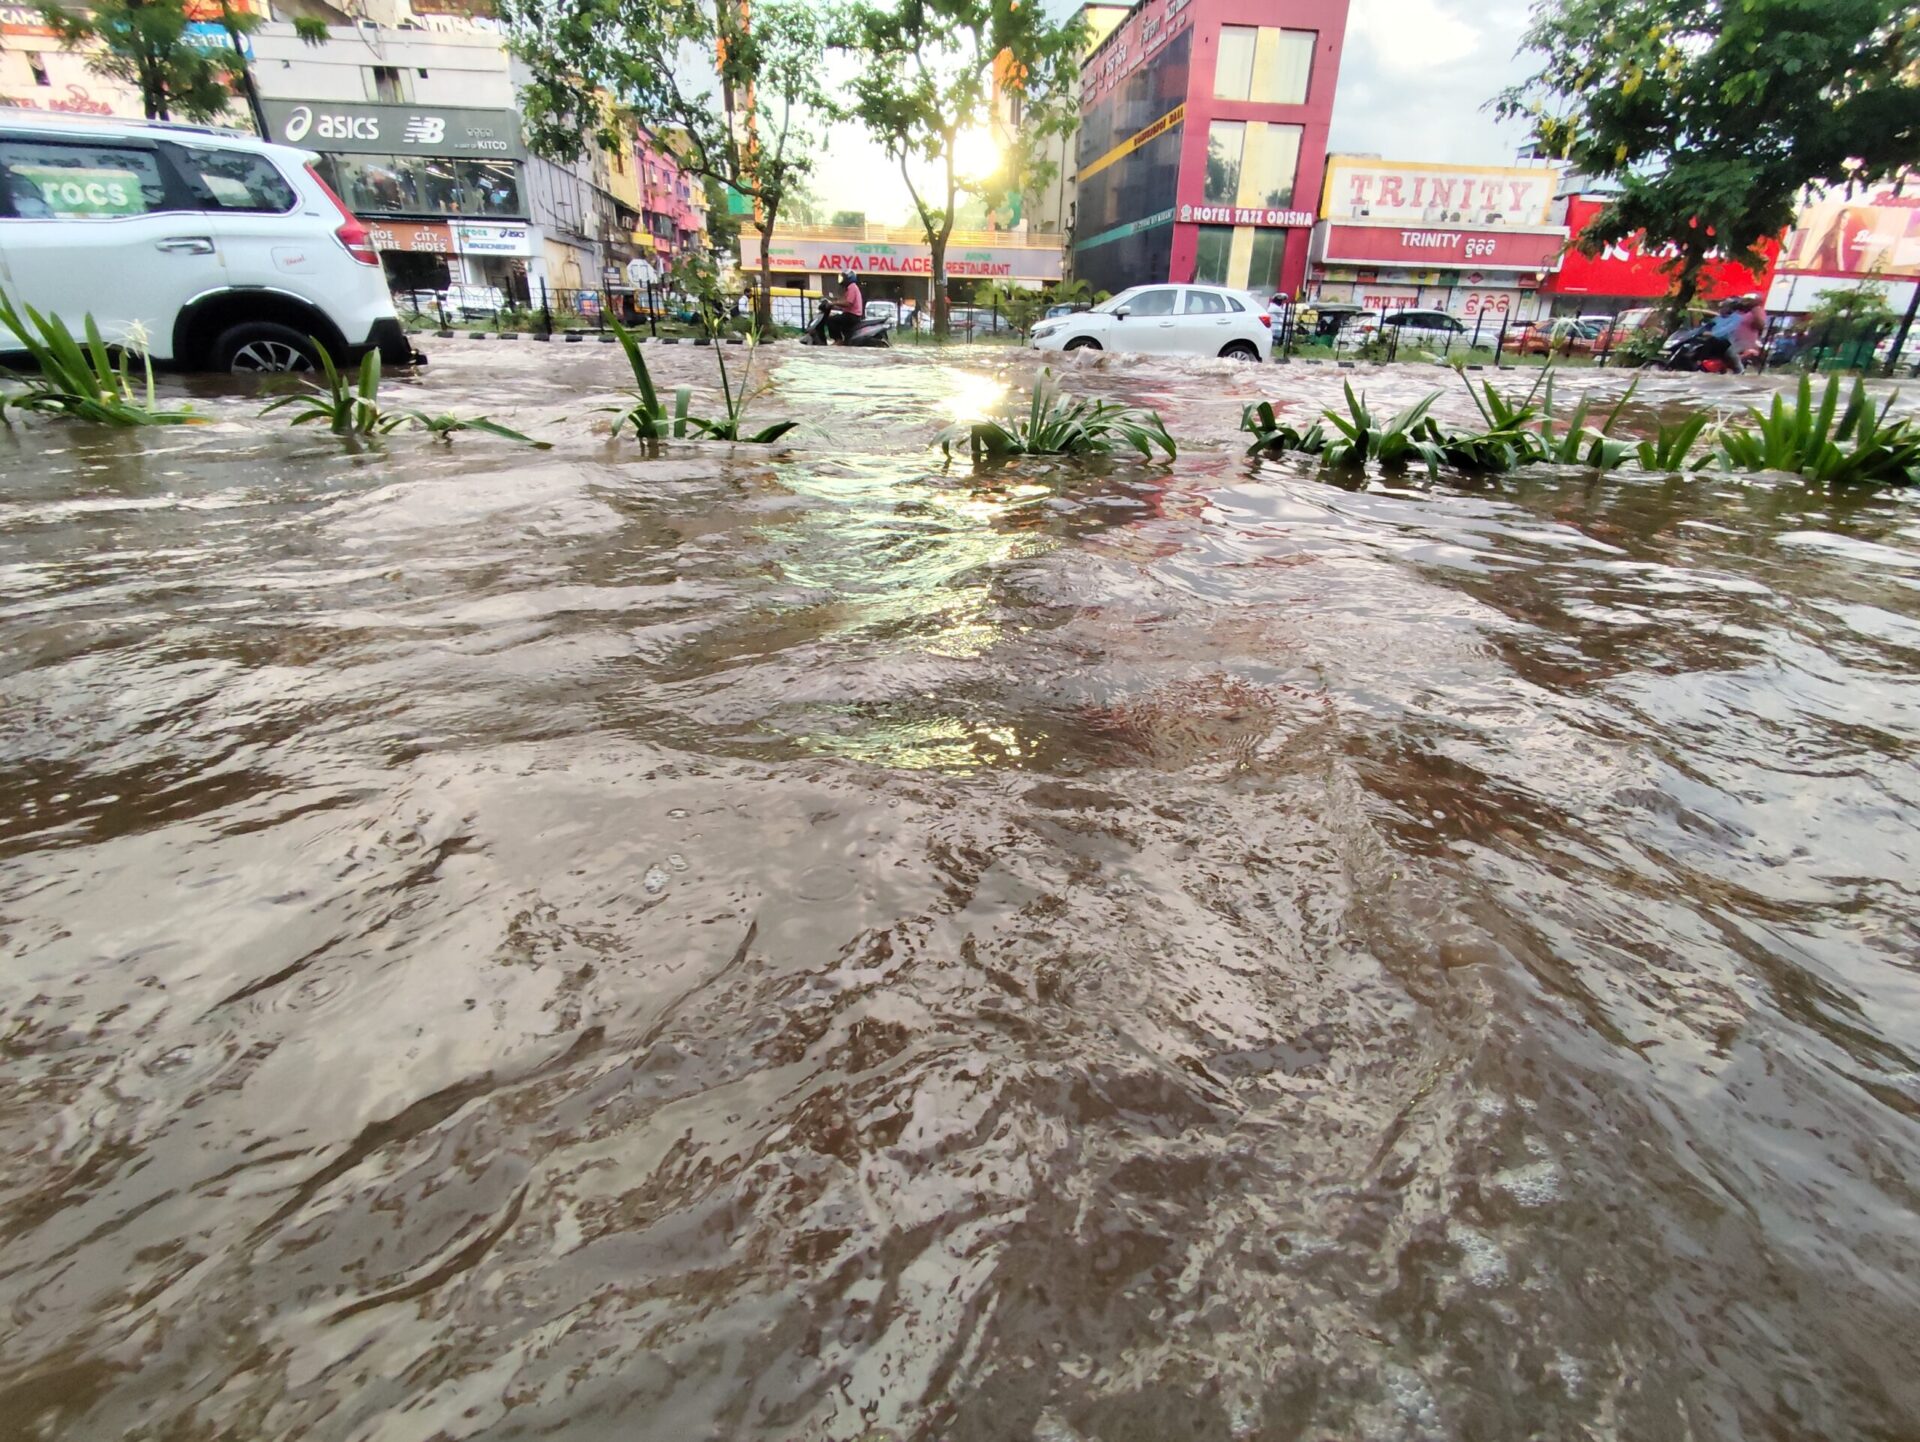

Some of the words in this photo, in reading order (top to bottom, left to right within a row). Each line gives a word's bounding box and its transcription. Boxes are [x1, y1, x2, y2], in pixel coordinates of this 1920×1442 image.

[318, 115, 379, 140] asics
[477, 140, 508, 150] KITCO
[1350, 174, 1533, 212] TRINITY
[1193, 206, 1231, 223] HOTEL
[1235, 209, 1264, 224] TAZZ
[1266, 210, 1313, 226] ODISHA
[414, 232, 438, 242] CITY
[1401, 232, 1462, 248] TRINITY
[411, 242, 447, 252] SHOES
[818, 255, 863, 271] ARYA
[867, 257, 932, 273] PALACE
[945, 262, 1011, 275] RESTAURANT
